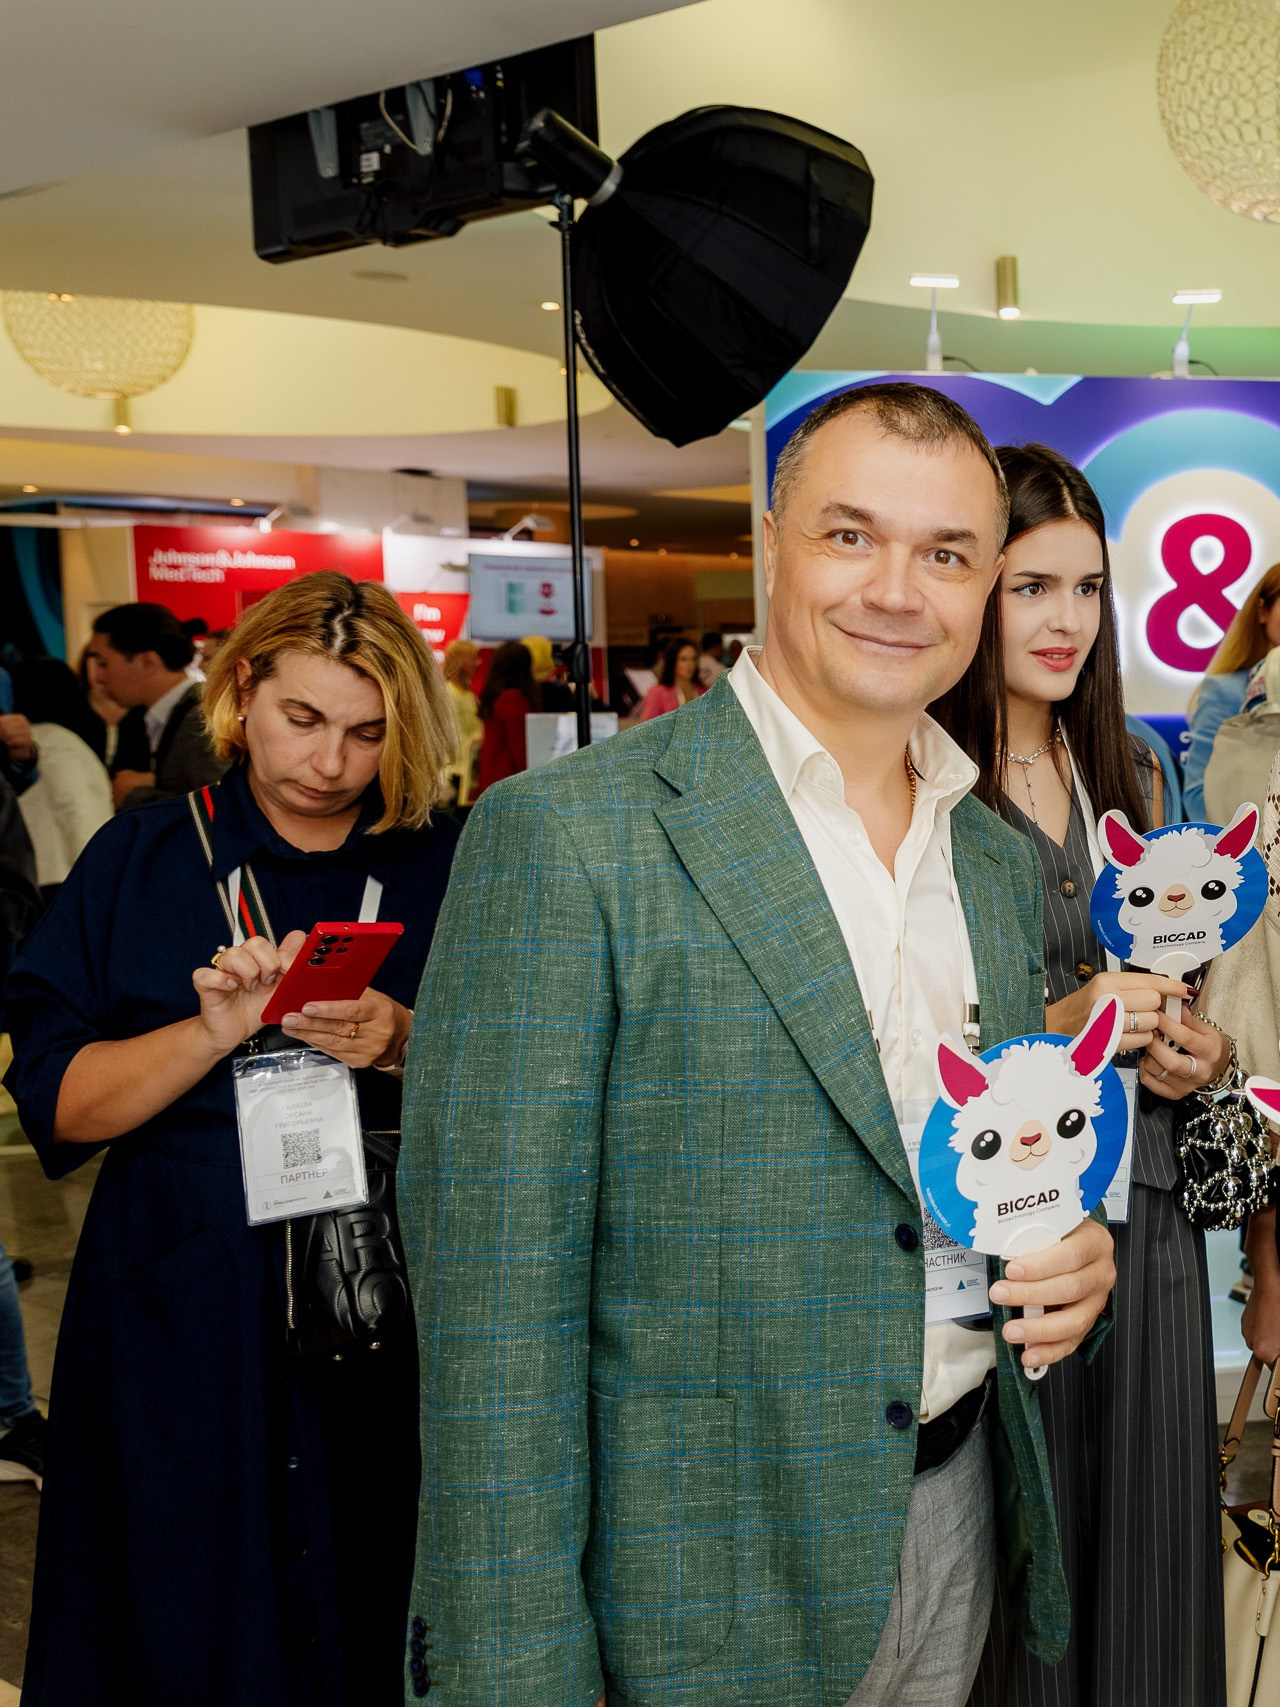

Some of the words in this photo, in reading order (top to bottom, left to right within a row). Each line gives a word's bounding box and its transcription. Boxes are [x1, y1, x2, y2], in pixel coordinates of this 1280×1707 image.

[280, 1168, 329, 1185] ПАРТНЕР
[997, 1211, 1035, 1224] Biotechnology
[1035, 1203, 1061, 1215] Company
[924, 1251, 967, 1268] ЧАСТНИК
